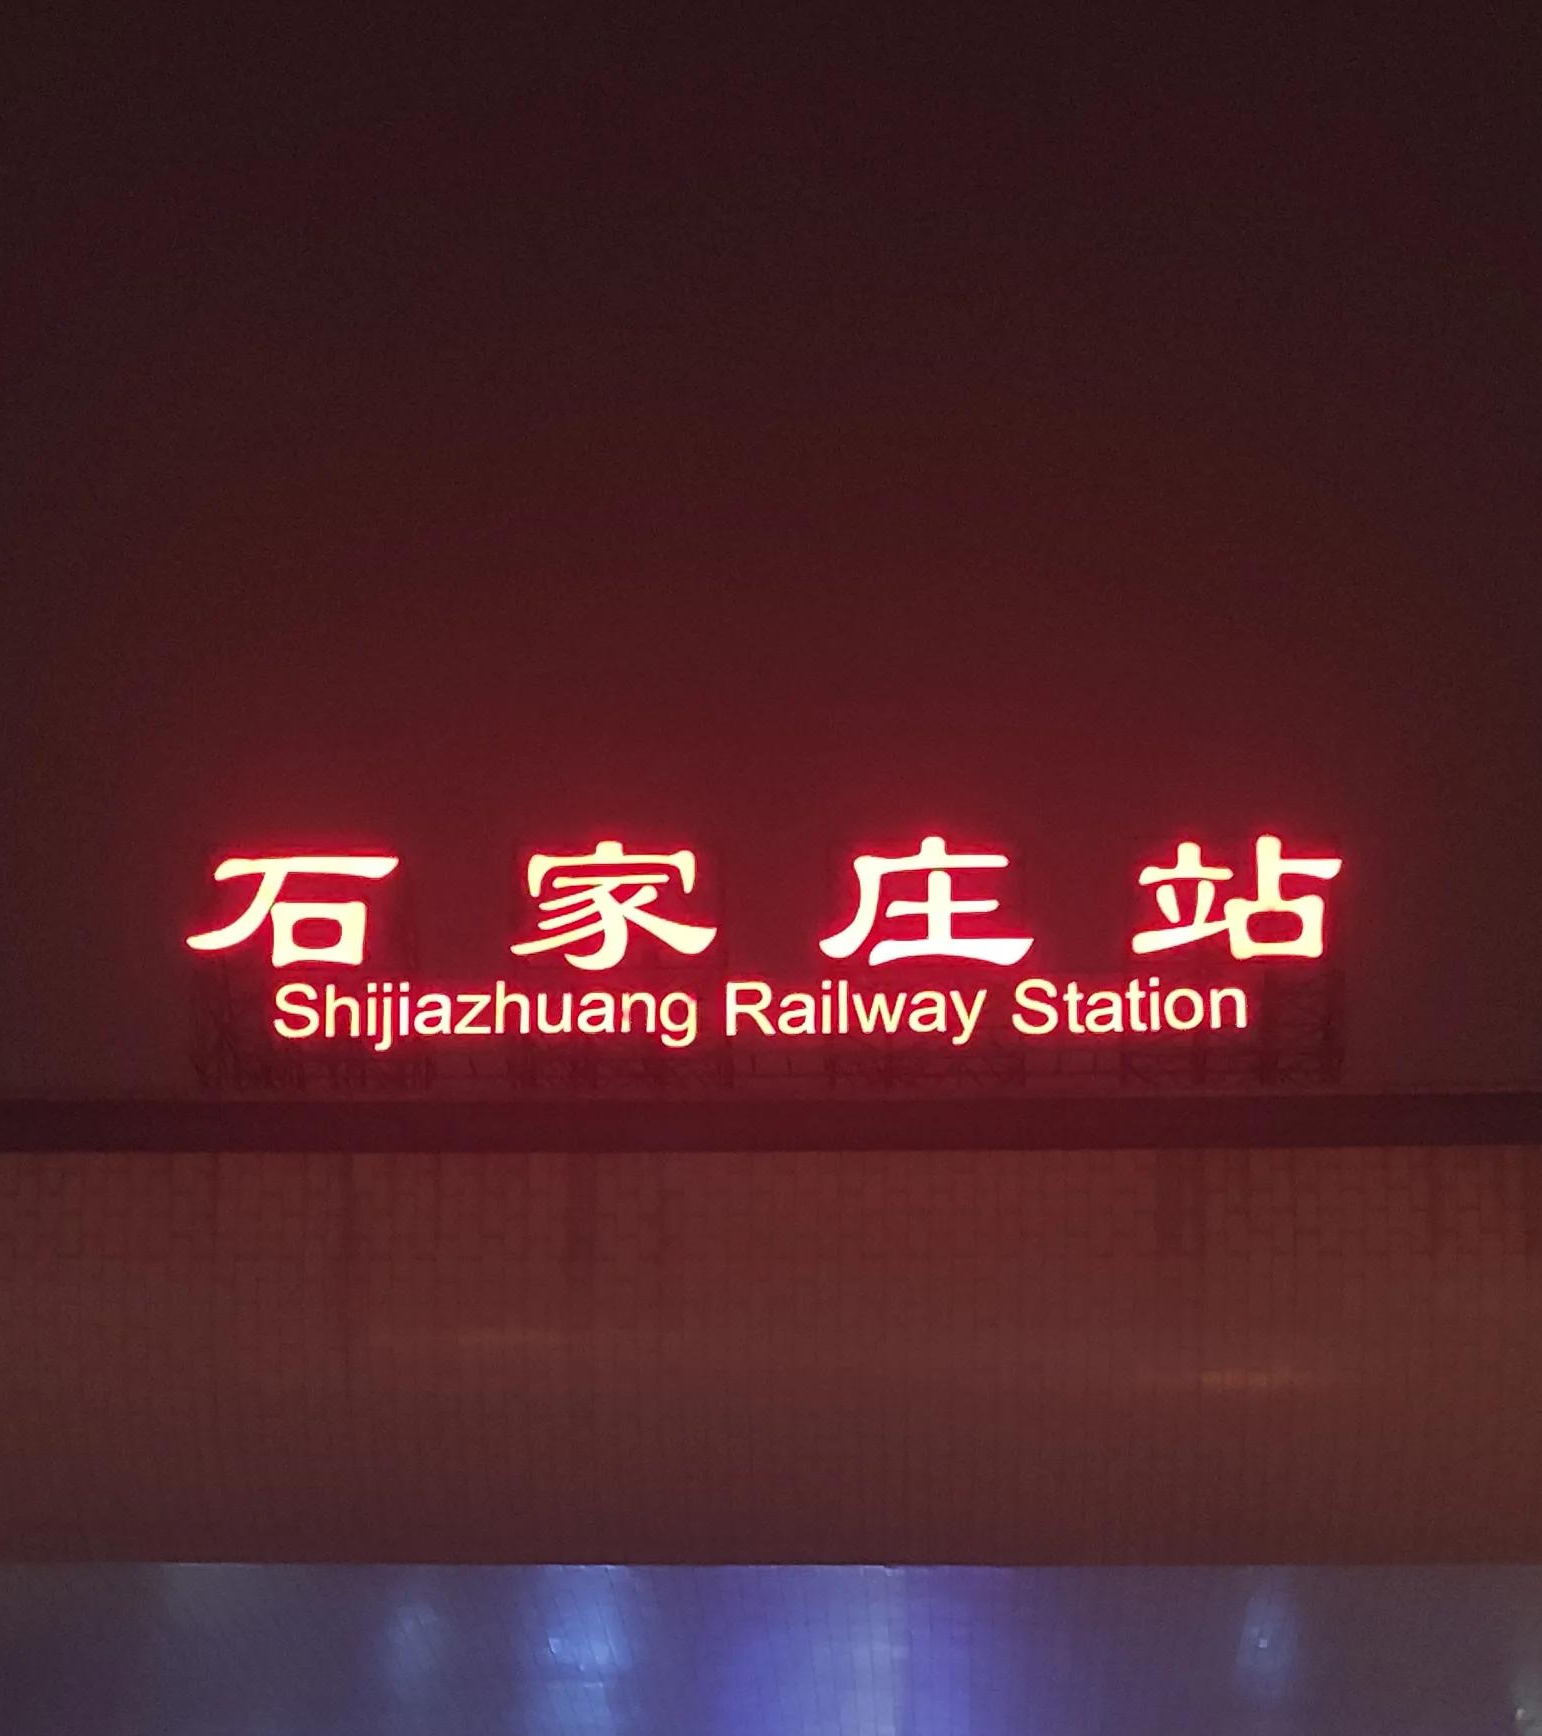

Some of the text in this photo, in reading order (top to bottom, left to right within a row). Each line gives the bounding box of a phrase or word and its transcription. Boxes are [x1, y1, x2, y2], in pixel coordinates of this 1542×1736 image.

[188, 836, 1343, 970] 石家庄站
[273, 977, 1248, 1053] Shijiazhuang Railway Station
